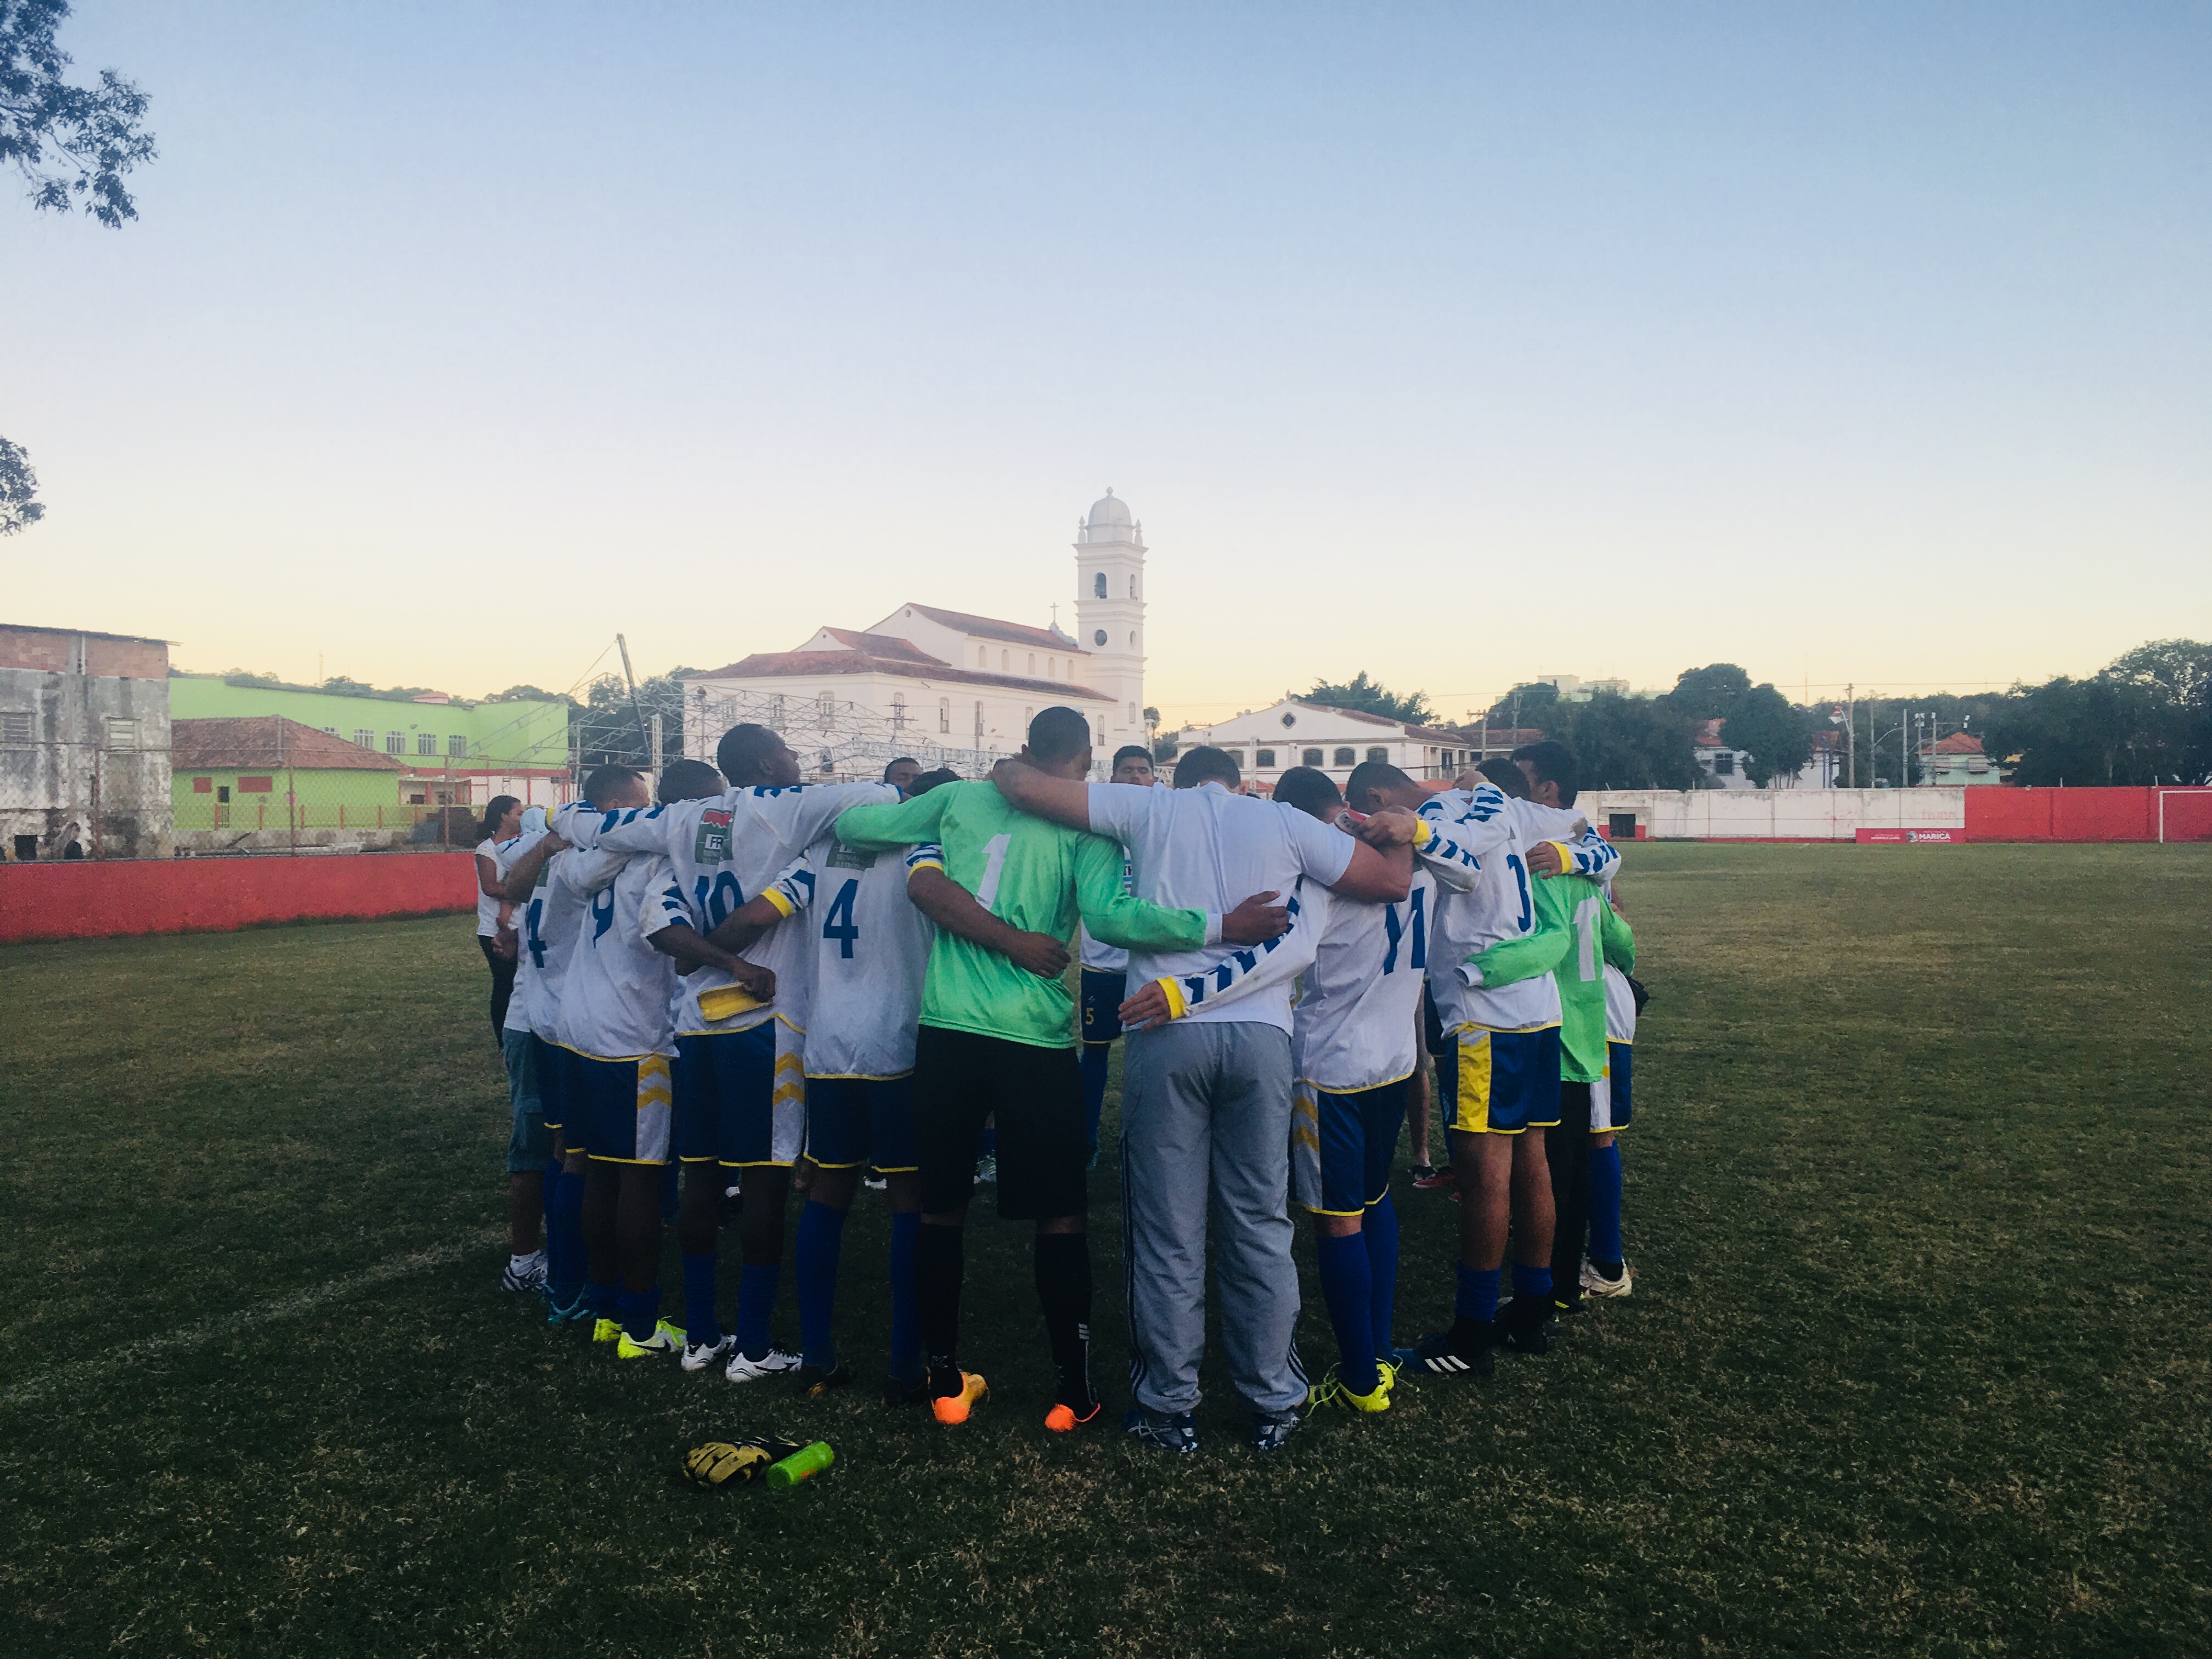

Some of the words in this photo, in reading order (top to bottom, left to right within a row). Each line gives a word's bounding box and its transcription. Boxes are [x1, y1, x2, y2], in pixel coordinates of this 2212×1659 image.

[695, 870, 745, 937] 10
[975, 833, 1012, 911] 1
[823, 879, 859, 958] 4
[1086, 1007, 1094, 1025] 5
